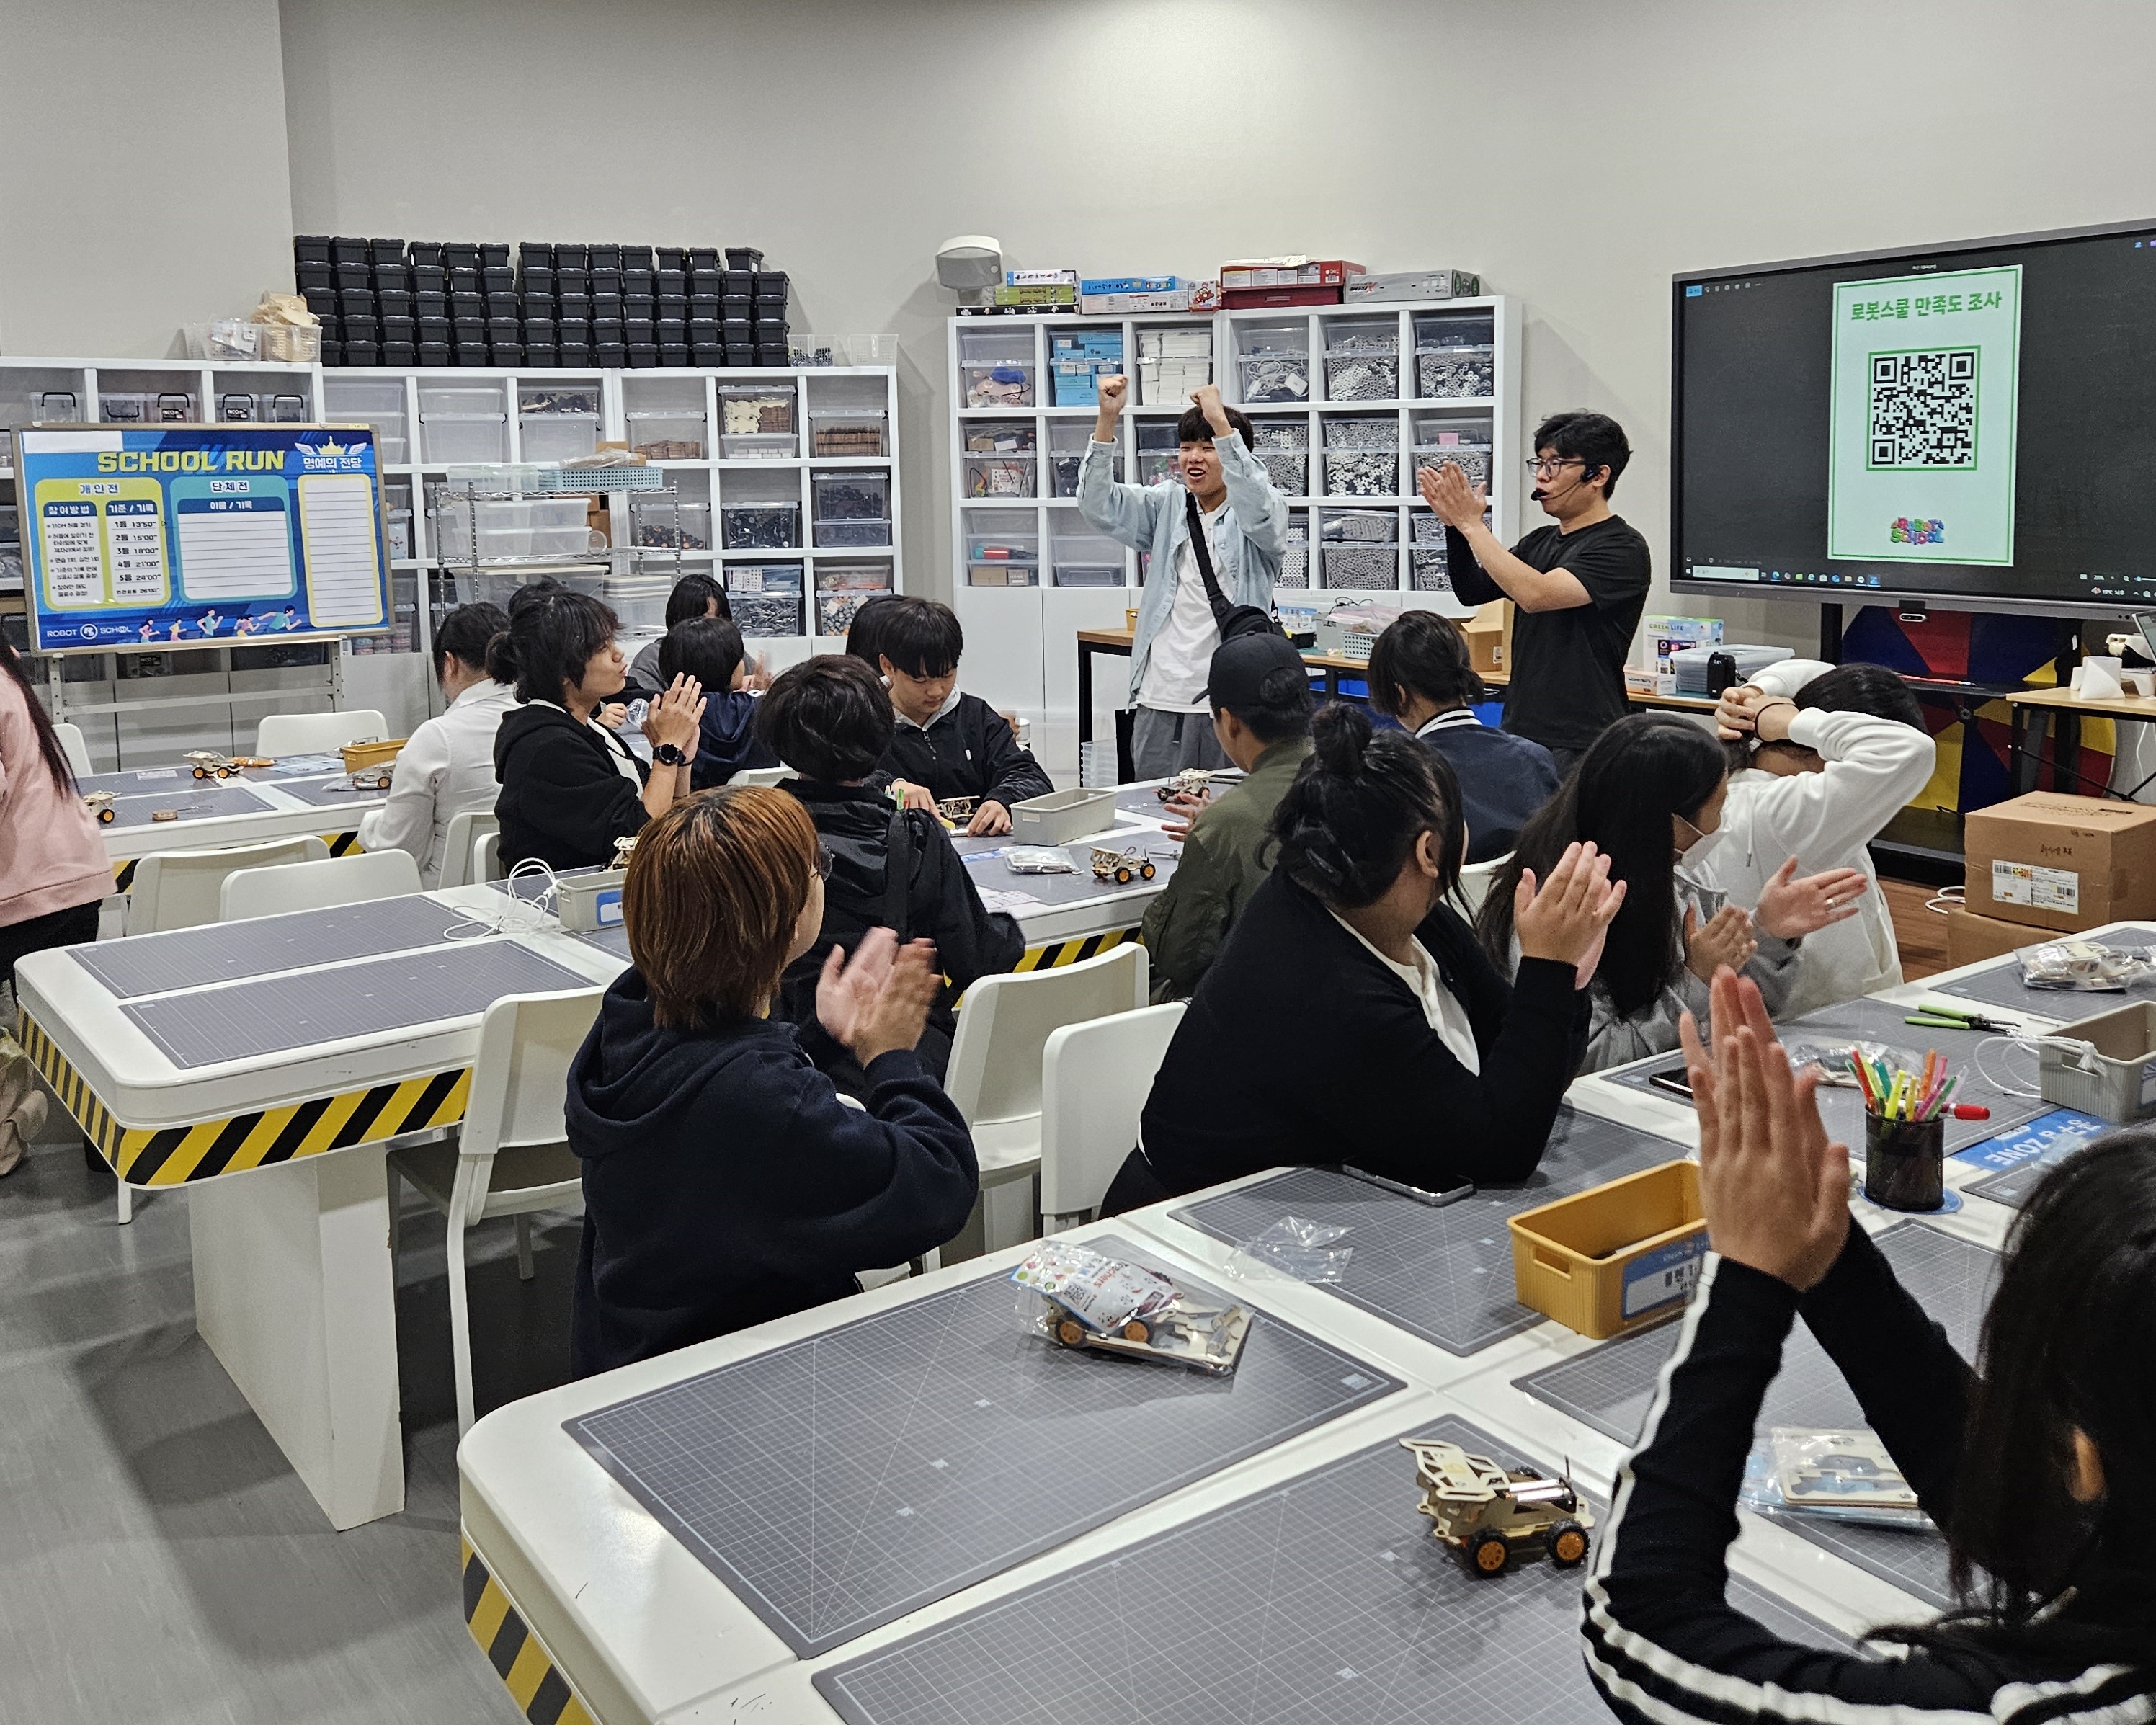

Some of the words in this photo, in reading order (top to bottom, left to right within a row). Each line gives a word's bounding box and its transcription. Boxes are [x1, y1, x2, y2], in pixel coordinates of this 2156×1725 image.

[1851, 298, 1910, 321] 로봇스쿨
[1915, 295, 1962, 316] 만족도
[1968, 291, 2002, 311] 조사
[97, 450, 218, 473] SCHOOL
[226, 450, 286, 471] RUN
[303, 457, 337, 469] 명예의
[339, 456, 362, 468] 전당
[80, 483, 118, 494] 개인전
[212, 481, 249, 491] 단체전
[48, 505, 89, 514] 참여방법
[109, 504, 127, 513] 기준
[137, 504, 154, 512] 기록
[236, 500, 252, 509] 기록
[1984, 1138, 2051, 1166] ZONE
